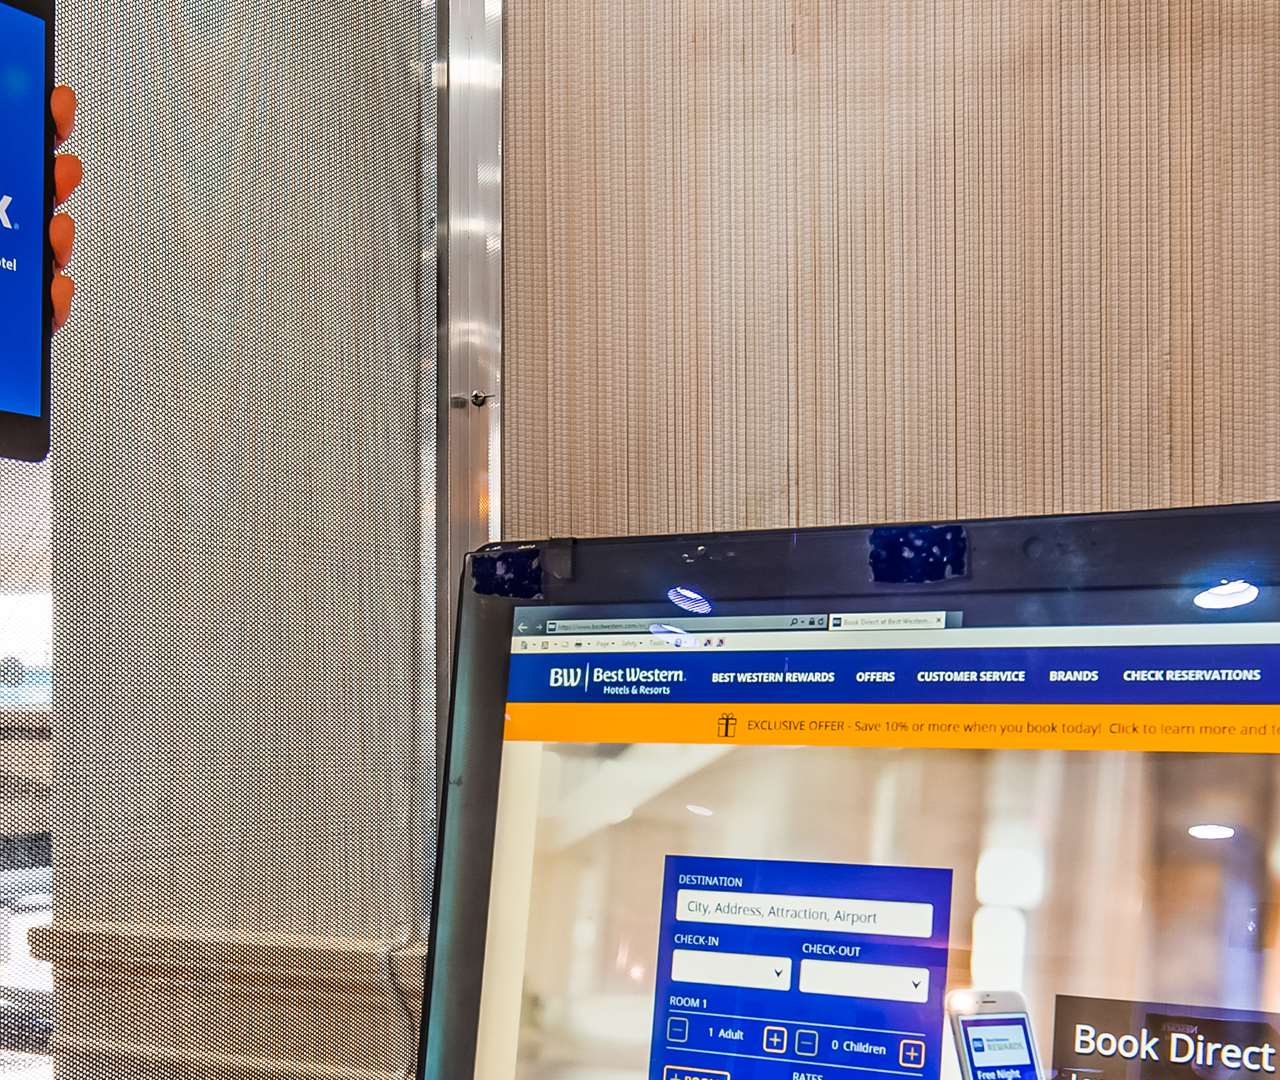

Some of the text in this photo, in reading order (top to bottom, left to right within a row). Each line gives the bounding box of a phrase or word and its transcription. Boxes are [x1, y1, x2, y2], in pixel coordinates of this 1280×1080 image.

[550, 668, 581, 687] BW
[593, 668, 624, 682] Best
[712, 671, 835, 683] BEST WESTERN REWARDS
[856, 671, 895, 682] OFFERS
[917, 671, 1025, 682] CUSTOMER SERVICE
[1049, 670, 1099, 682] BRANDS
[1123, 669, 1261, 681] CHECK RESERVATIONS
[603, 686, 670, 695] Hotels & Resorts
[748, 720, 806, 731] EXCLUSIVE
[809, 720, 844, 731] OFFER
[855, 721, 884, 732] Save
[886, 721, 908, 732] 10%
[912, 723, 925, 732] or
[928, 723, 960, 732] more
[963, 721, 996, 733] when
[1000, 724, 1023, 735] you
[1027, 721, 1057, 733] book
[1109, 722, 1139, 734] Click
[1144, 724, 1157, 735] to
[1161, 723, 1195, 735] learn
[1200, 725, 1236, 735] more
[1240, 724, 1266, 736] and
[678, 874, 743, 887] DESTINATION
[687, 900, 877, 925] City, Address, Attraction, Airport
[674, 934, 719, 946] CHECK-IN
[802, 943, 861, 957] CHECK-OUT
[670, 995, 700, 1008] ROOM
[708, 1027, 744, 1041] 1 Adult
[831, 1039, 886, 1055] 0 Children
[1074, 1024, 1160, 1061] Book
[1169, 1032, 1276, 1073] Direct
[977, 1070, 996, 1080] Free
